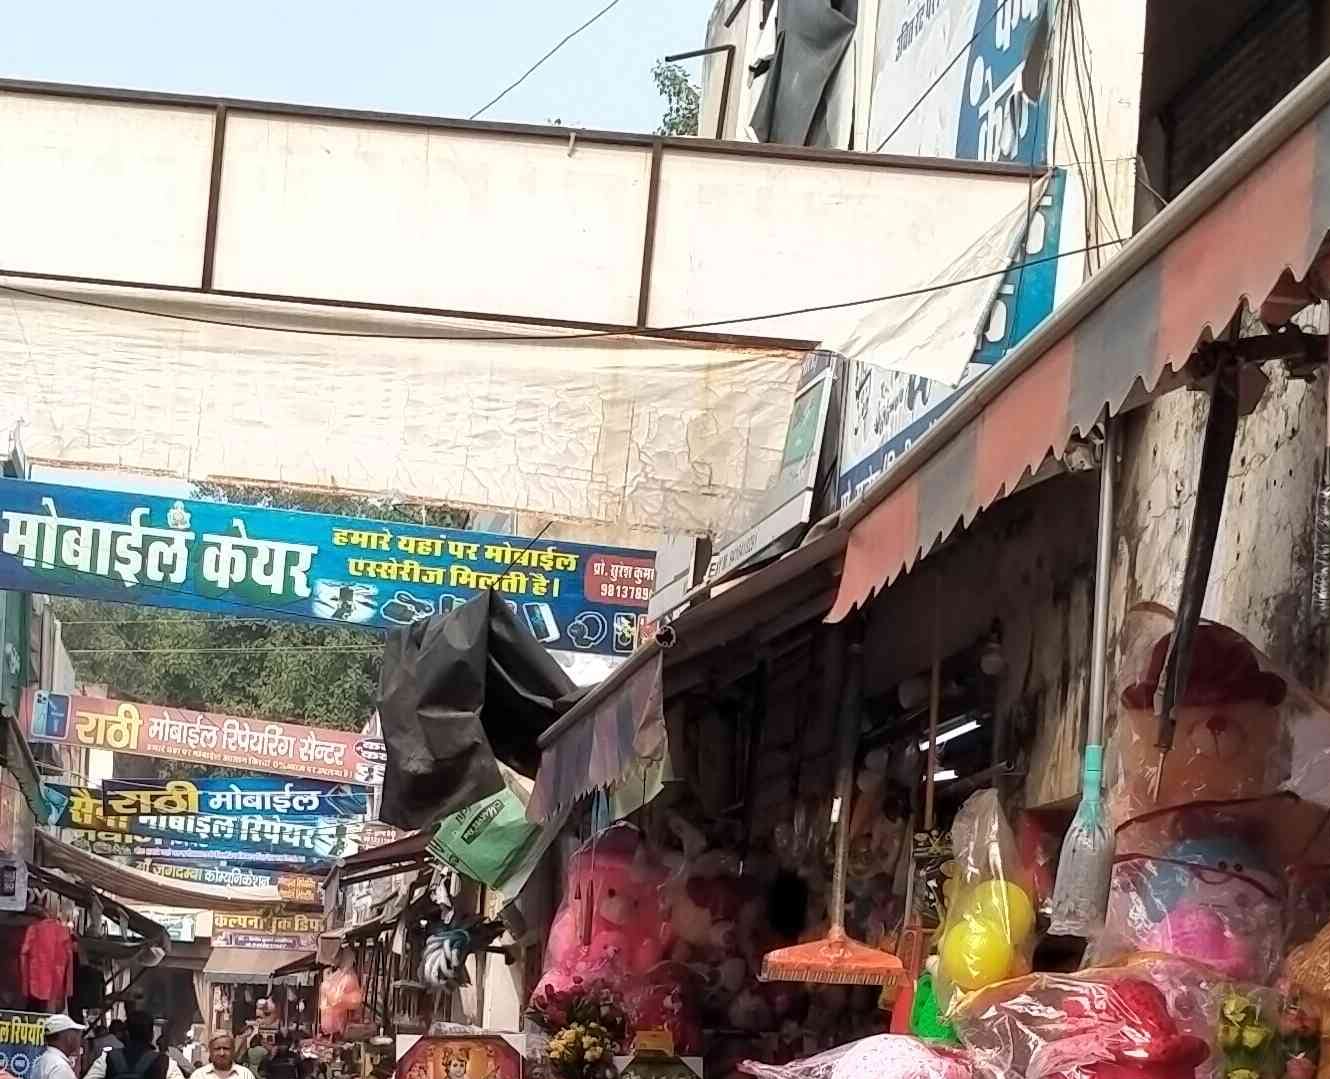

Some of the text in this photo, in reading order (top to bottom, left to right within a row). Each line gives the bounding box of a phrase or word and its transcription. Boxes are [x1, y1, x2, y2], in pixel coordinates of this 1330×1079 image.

[2, 497, 319, 598] मोबाईल केयर
[331, 526, 579, 572] हमारे यहां पर मोबाईल
[450, 563, 528, 595] मिलती
[76, 703, 143, 750] राठी
[148, 711, 219, 750] मोबाईल
[106, 781, 322, 814] राठी मोबाईल
